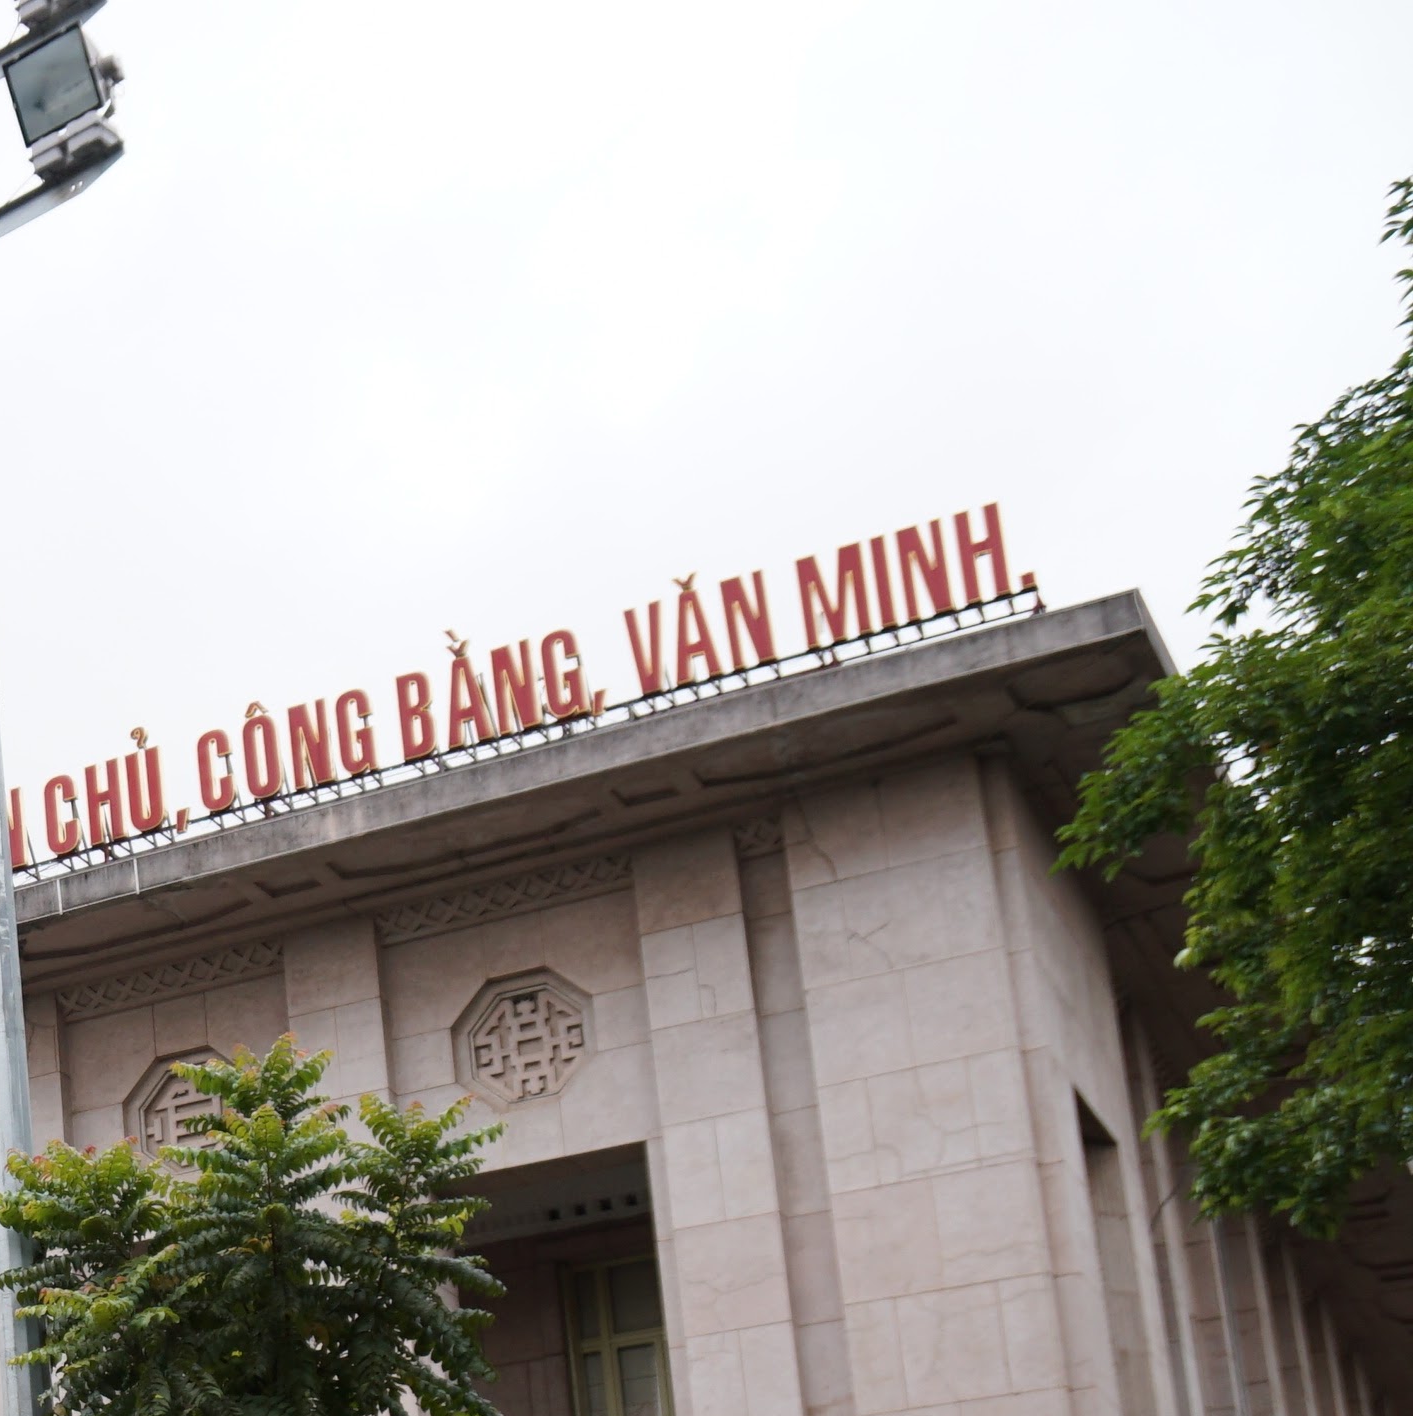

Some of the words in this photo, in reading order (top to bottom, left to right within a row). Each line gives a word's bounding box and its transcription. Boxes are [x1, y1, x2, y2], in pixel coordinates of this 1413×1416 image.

[44, 726, 190, 856] CHỦ,
[196, 688, 378, 813] CÔNG
[395, 629, 609, 761] BẰNG,
[623, 570, 777, 697] VĂN
